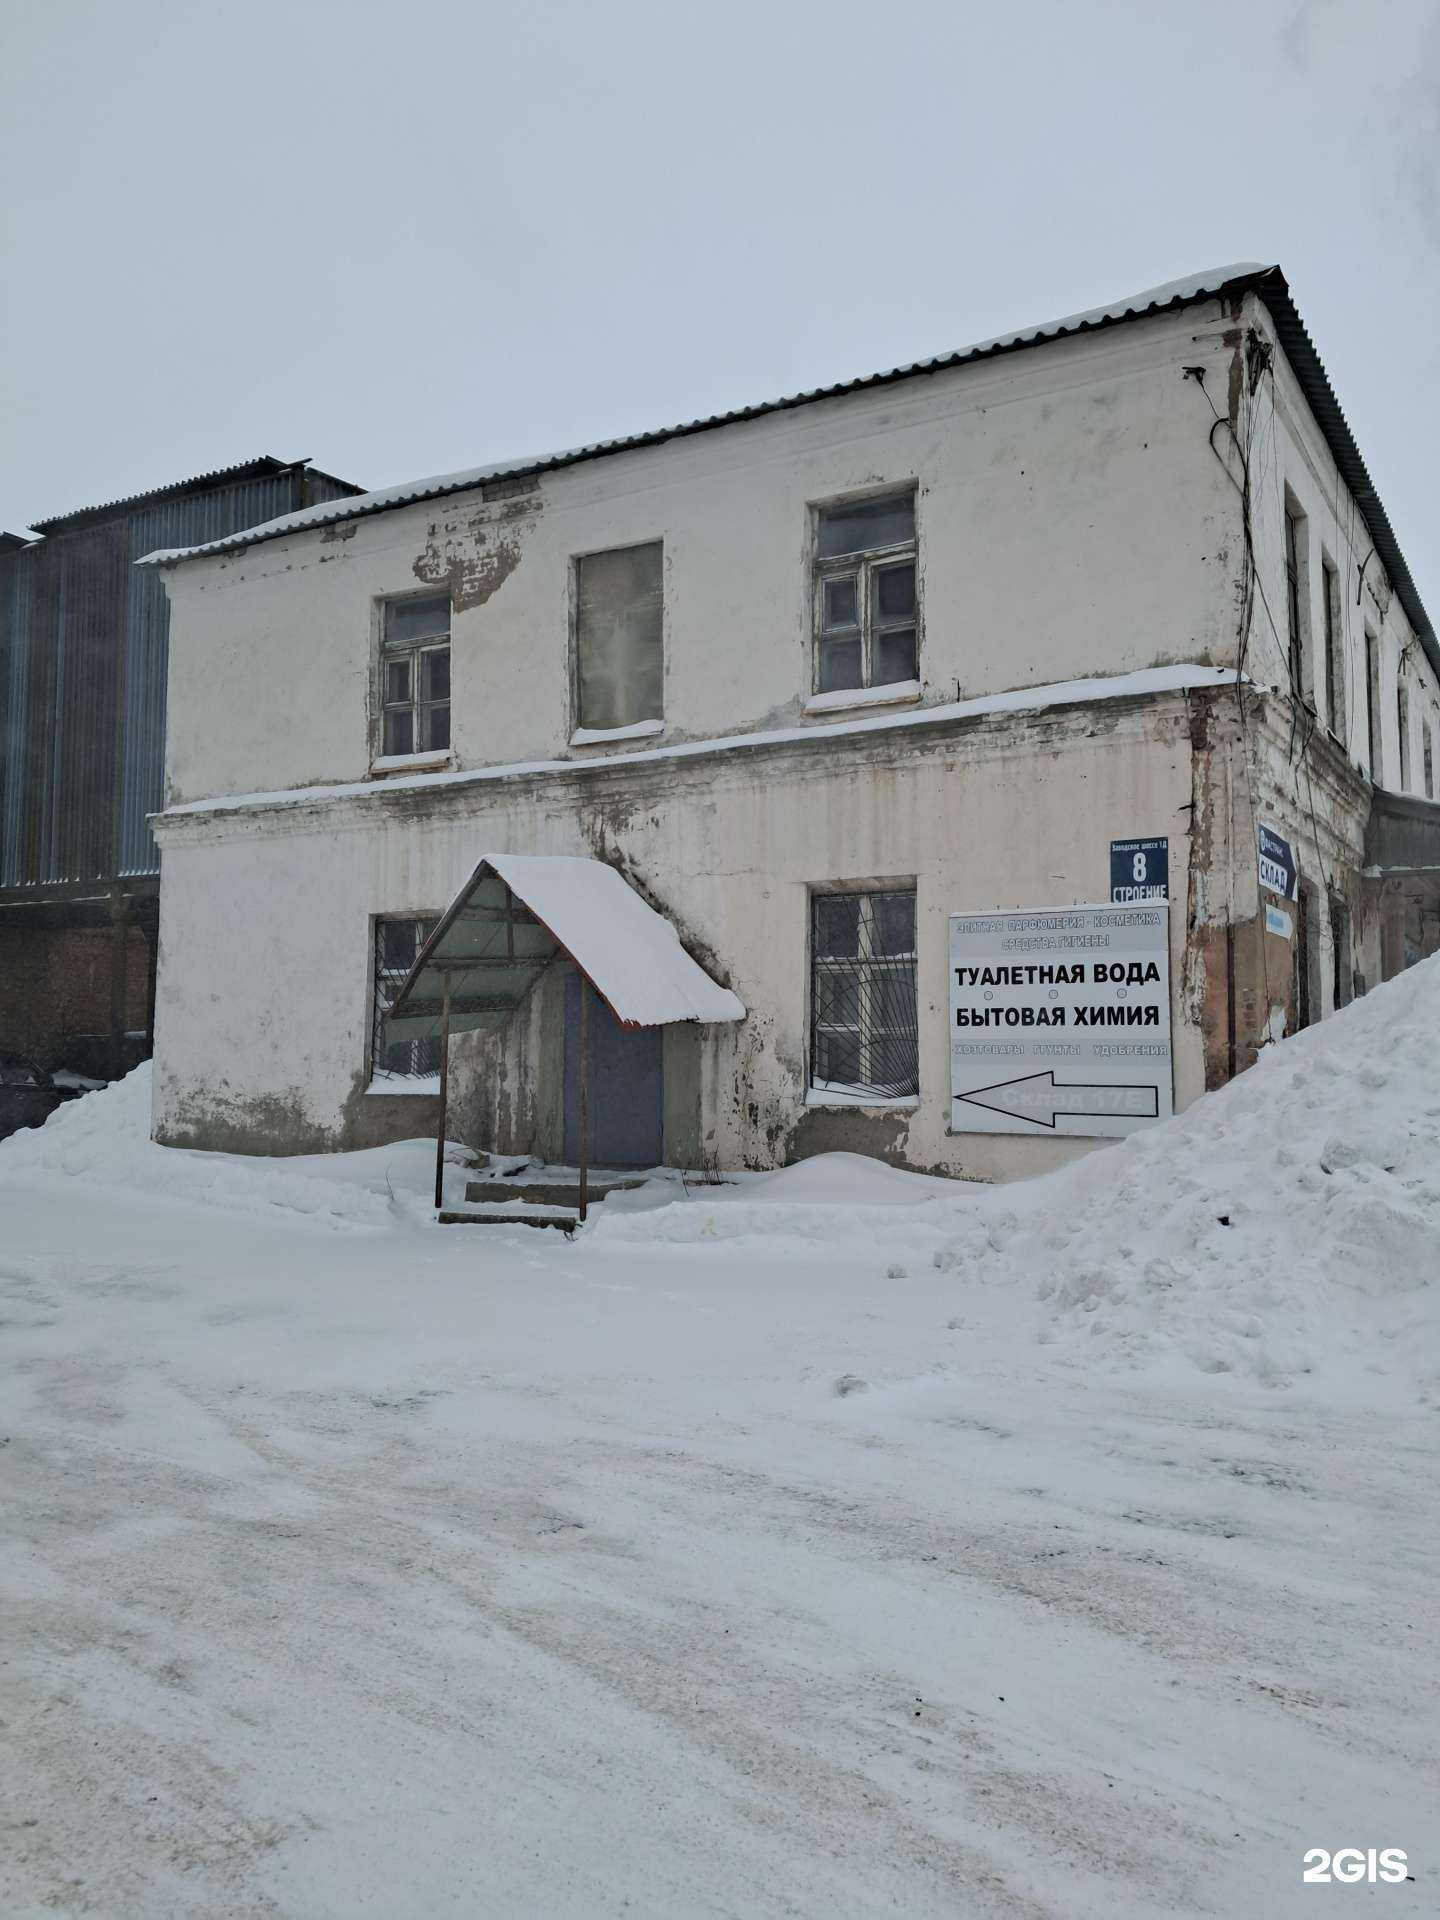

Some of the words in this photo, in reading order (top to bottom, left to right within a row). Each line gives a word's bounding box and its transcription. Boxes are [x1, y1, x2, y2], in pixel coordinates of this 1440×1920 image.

[1133, 852, 1147, 882] 8
[1260, 860, 1285, 891] СКЛАД
[1113, 884, 1167, 902] СТРОЕНИЕ
[1007, 916, 1085, 931] ПАРФЮМЕРИЯ
[1093, 913, 1161, 928] КОСМЕТИКА
[1002, 936, 1057, 950] СРЕДСТВА
[1057, 934, 1110, 948] ГИГИЕНЫ
[955, 964, 1085, 986] ТУАЛЕТНАЯ
[1093, 962, 1161, 987] ВОДА
[956, 1007, 1066, 1027] БЫТОВАЯ
[1073, 1006, 1160, 1026] ХИМИЯ
[1092, 1044, 1169, 1057] УДОБРЕНИЯ
